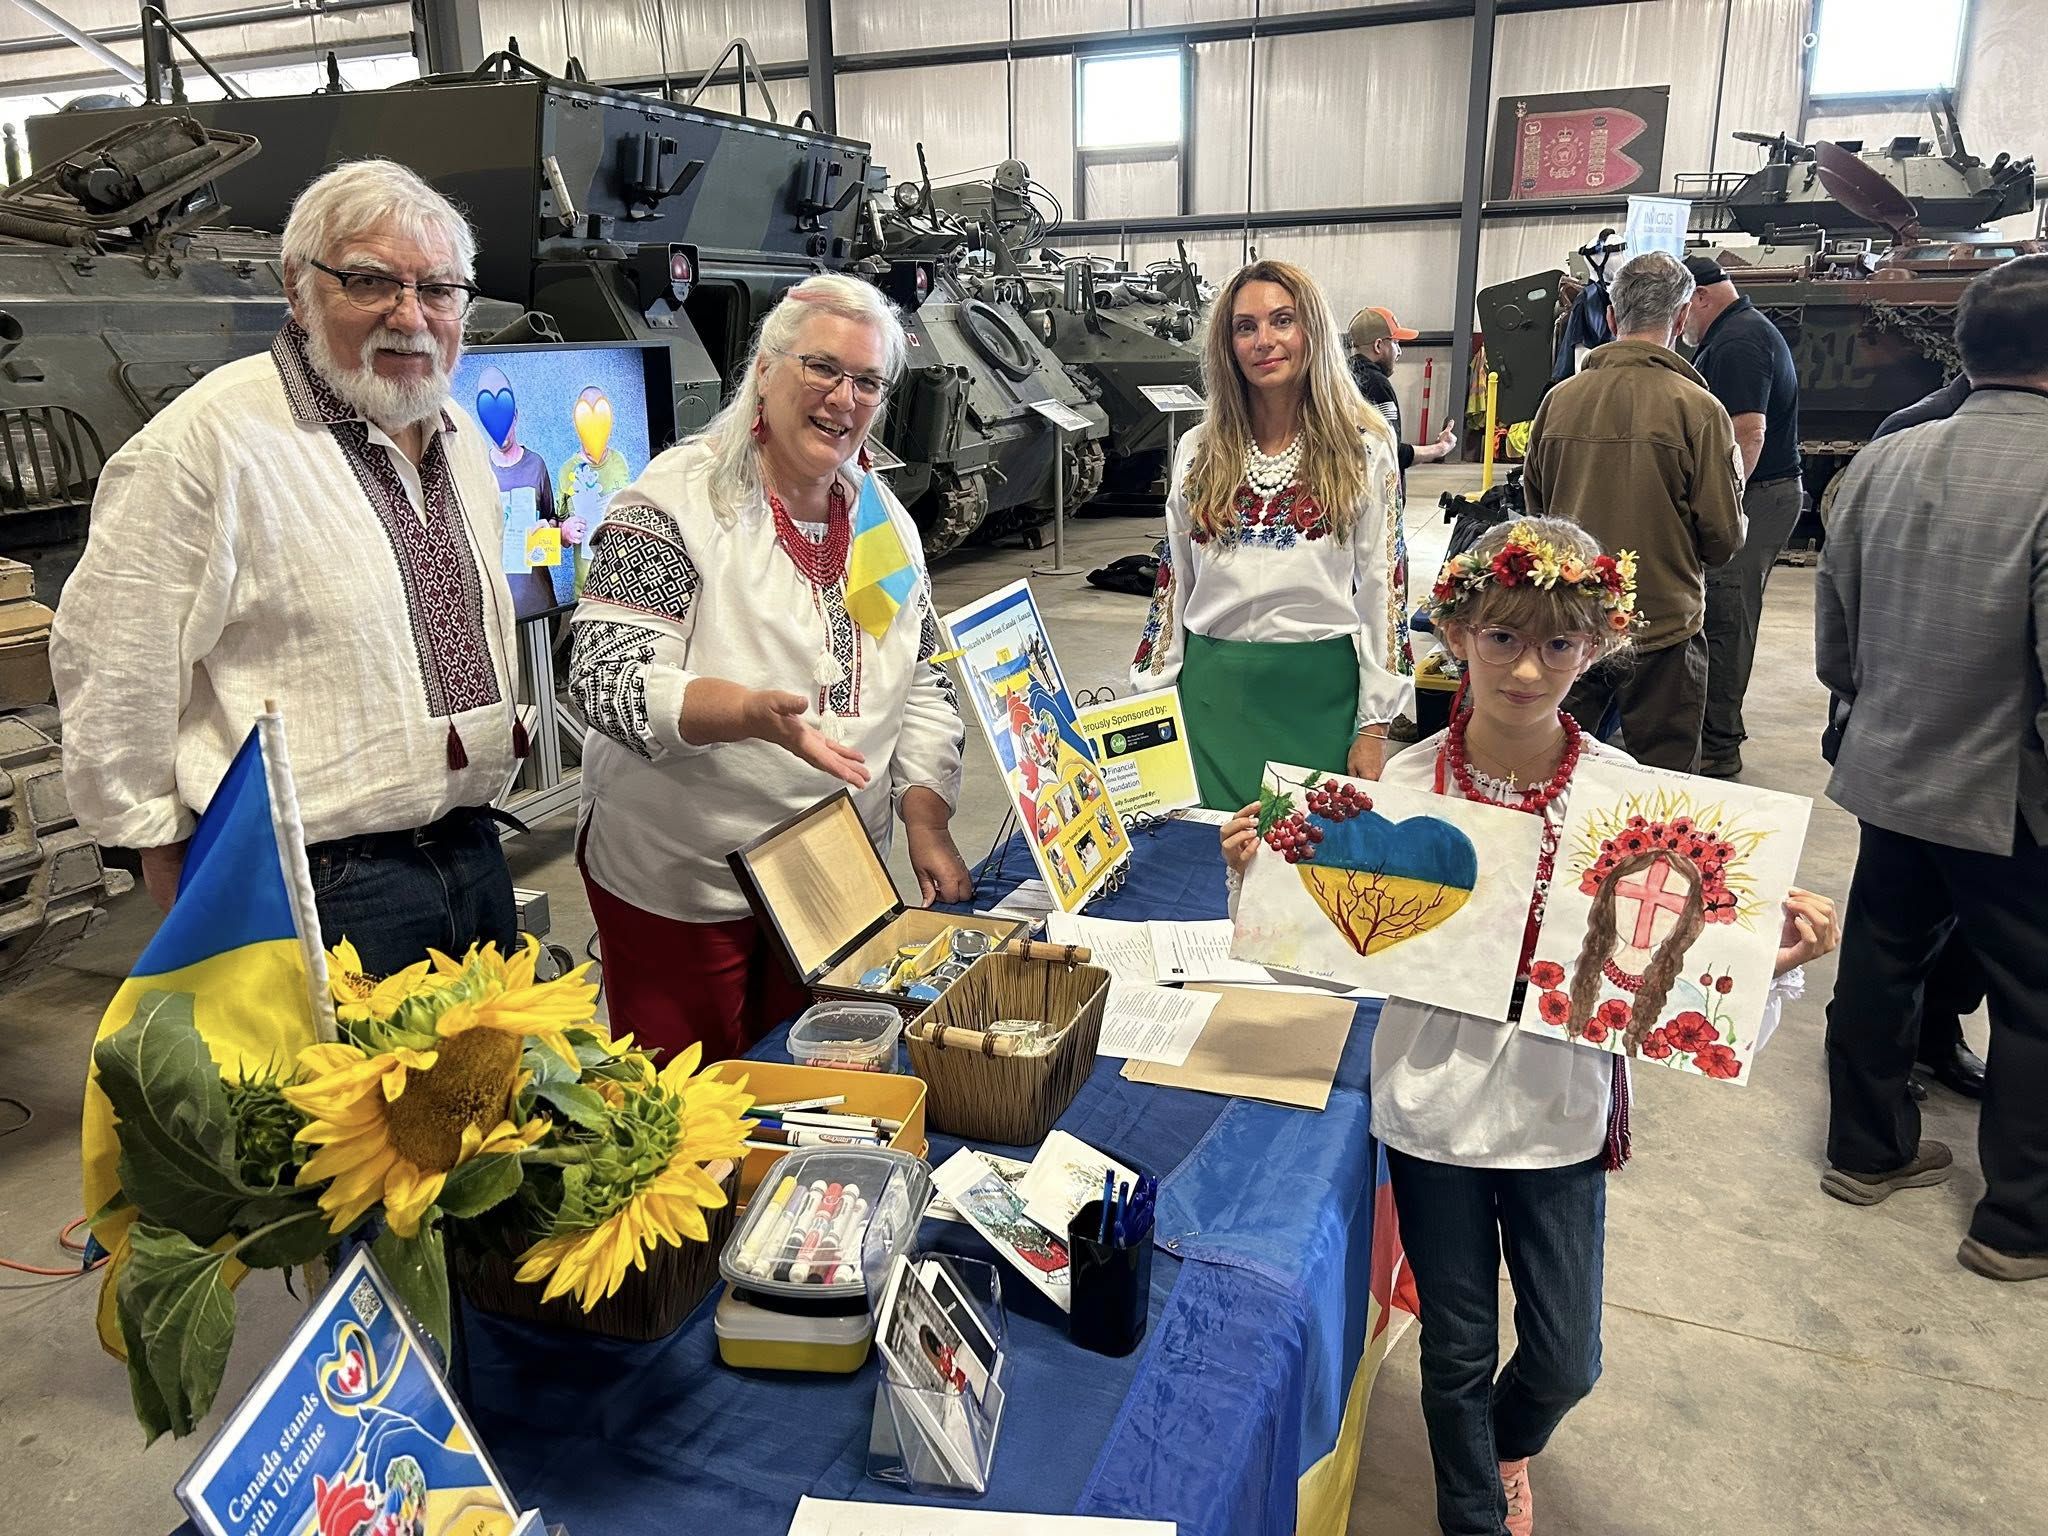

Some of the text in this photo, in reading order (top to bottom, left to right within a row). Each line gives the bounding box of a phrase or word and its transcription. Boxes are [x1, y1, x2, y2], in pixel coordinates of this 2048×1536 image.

[1644, 211, 1674, 225] INVICTUS
[1111, 706, 1154, 727] Sponsored
[1155, 704, 1168, 716] by:
[1107, 761, 1137, 775] Financial
[1124, 791, 1148, 804] Supported
[1133, 799, 1161, 810] Community
[228, 1392, 319, 1523] Canada stands
[272, 1423, 326, 1498] Ukraine
